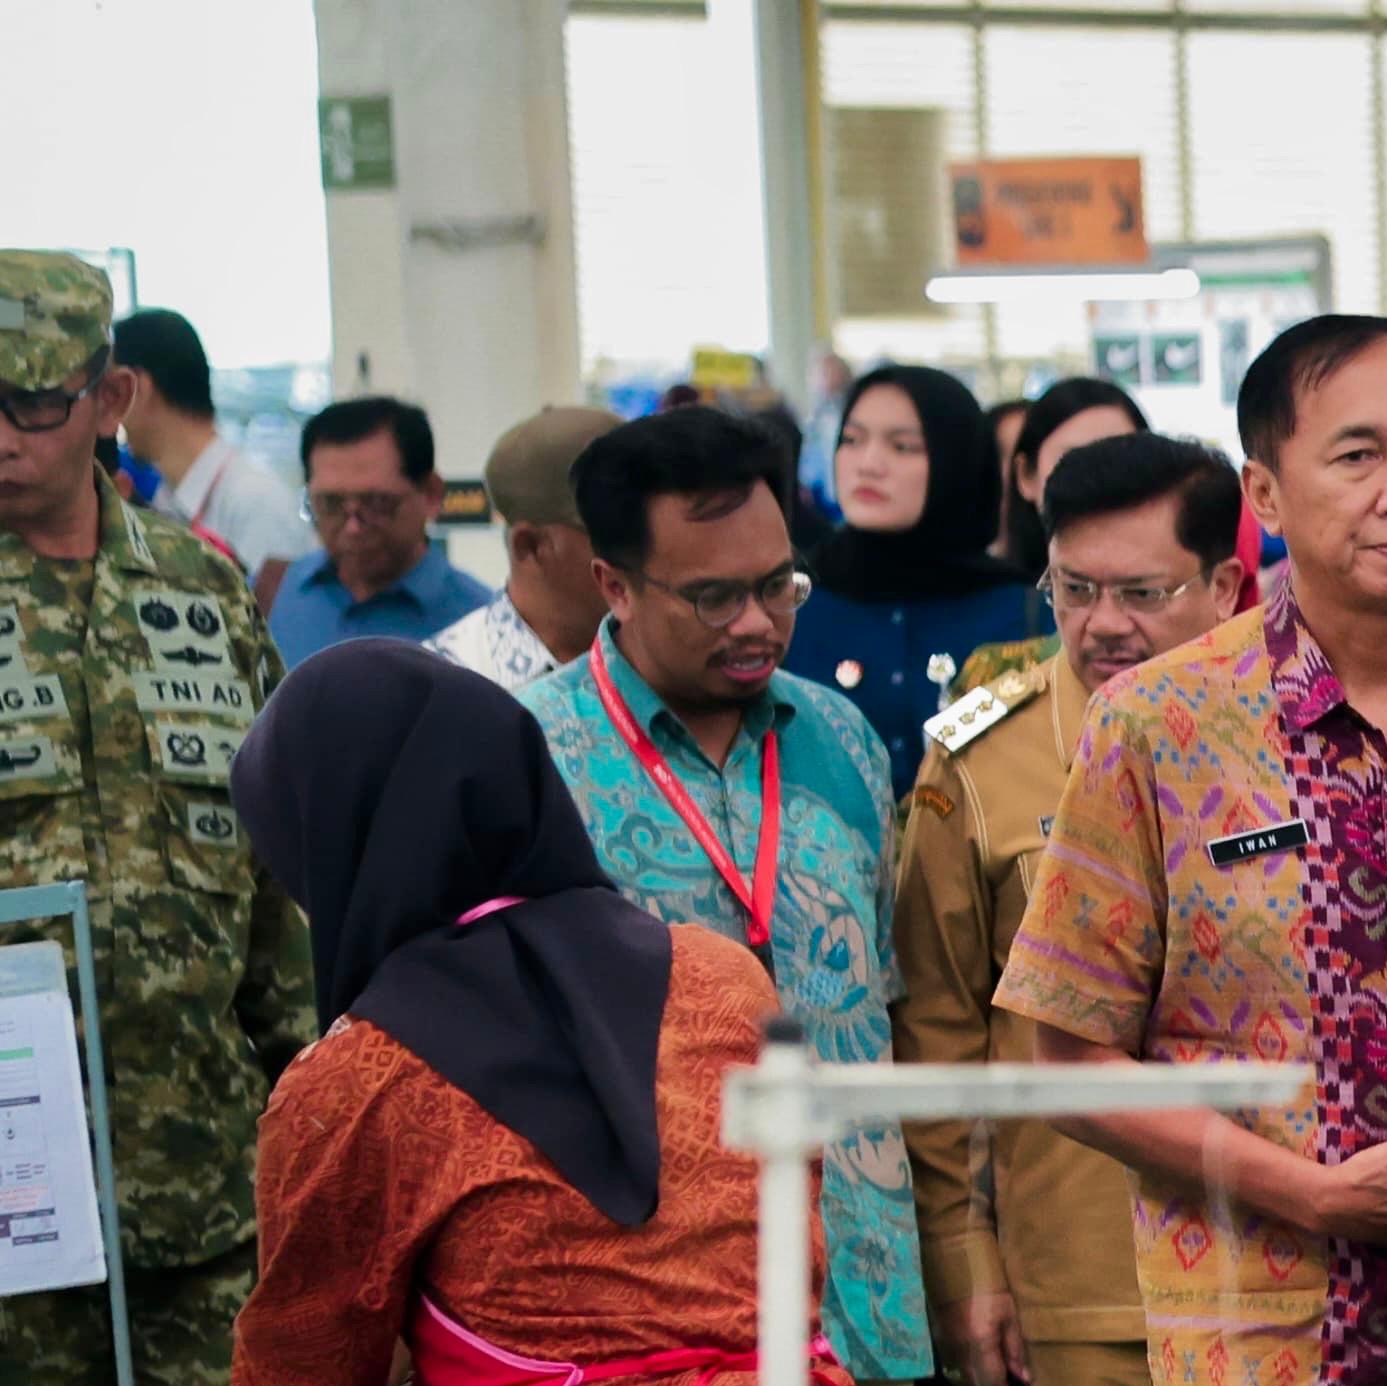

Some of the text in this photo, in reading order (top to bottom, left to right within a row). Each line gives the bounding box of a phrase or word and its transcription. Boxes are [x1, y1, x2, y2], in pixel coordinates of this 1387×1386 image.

[151, 680, 242, 707] TNI AD
[1238, 834, 1278, 854] IWAN
